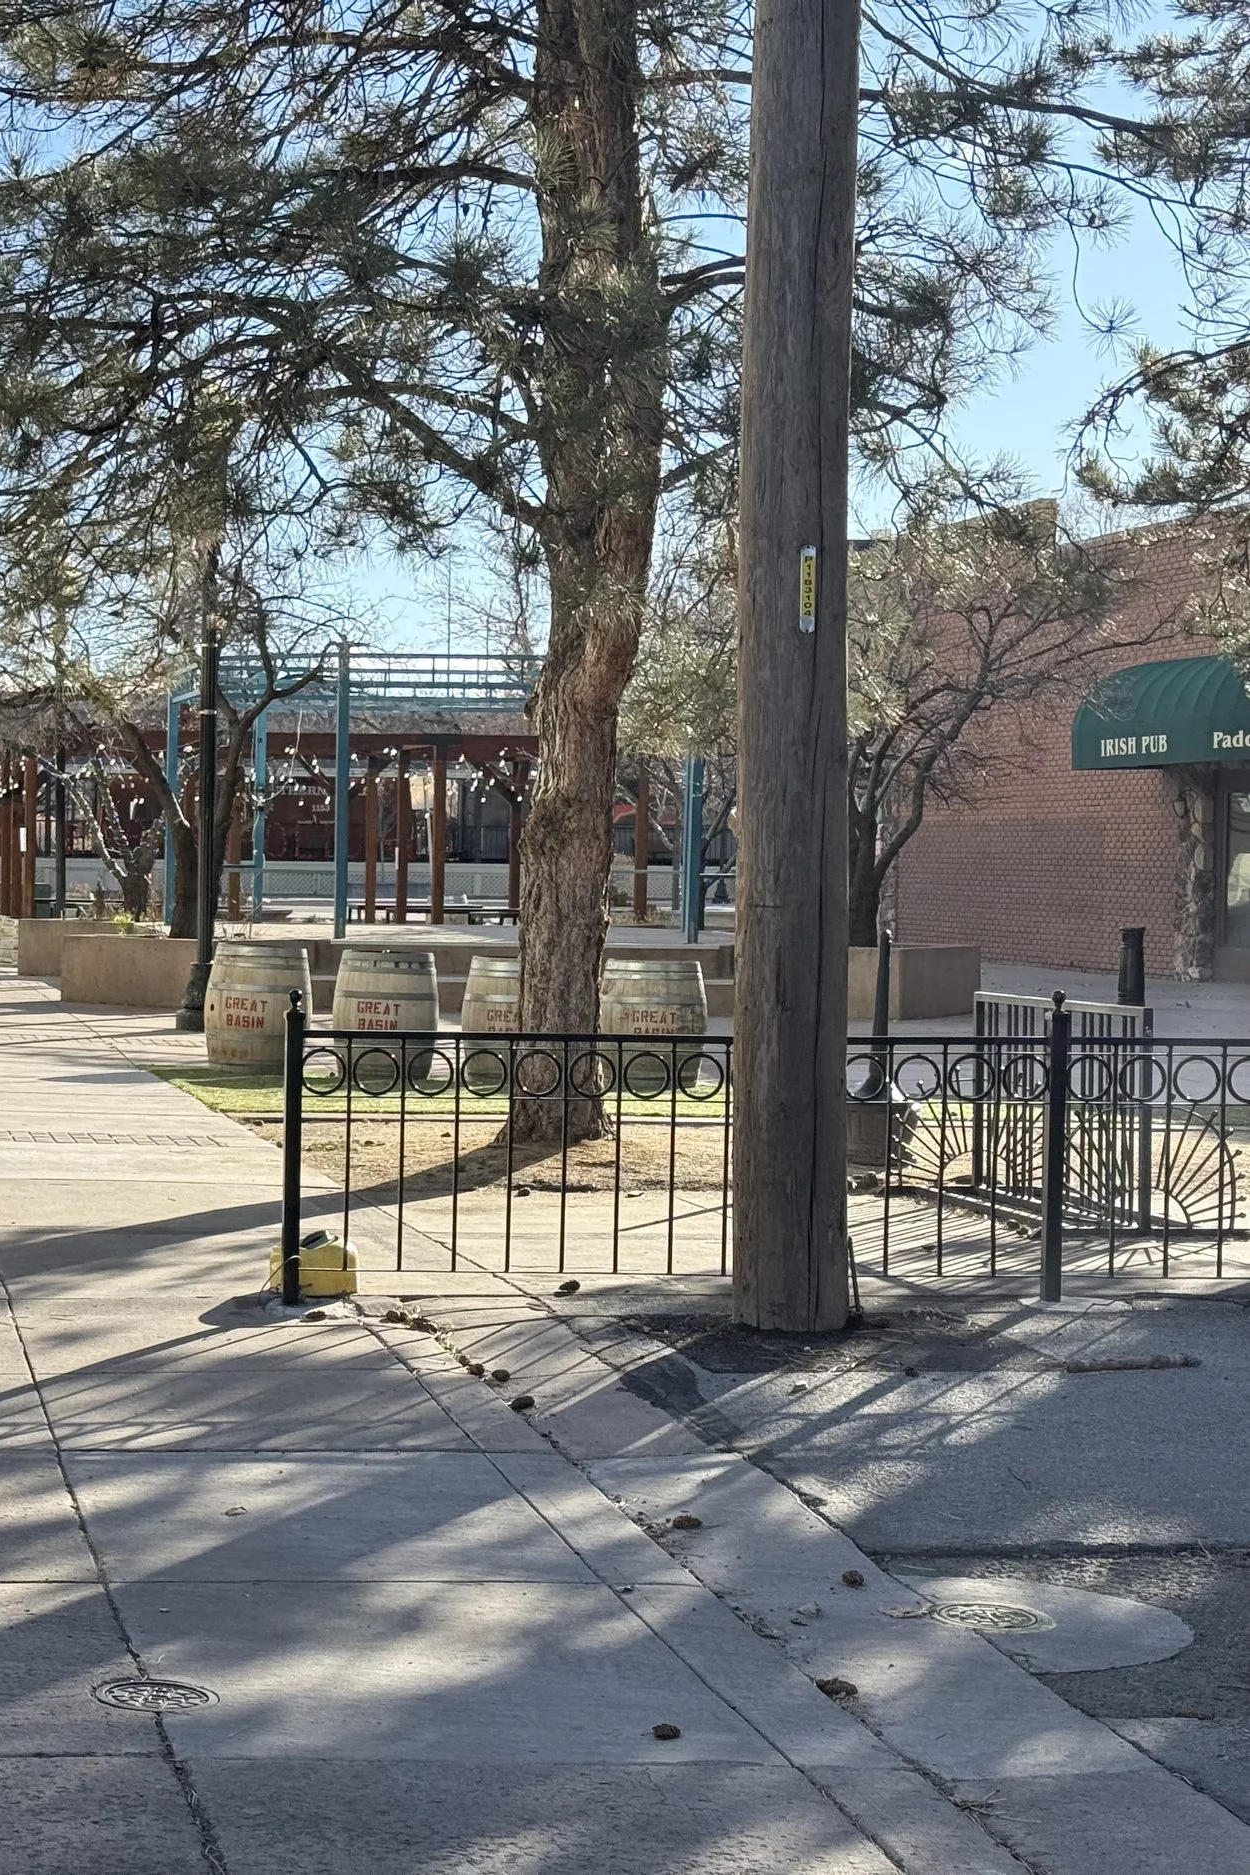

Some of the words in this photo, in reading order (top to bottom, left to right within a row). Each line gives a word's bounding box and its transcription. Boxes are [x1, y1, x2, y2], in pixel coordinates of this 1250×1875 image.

[1100, 736, 1136, 757] IRISH
[1141, 734, 1167, 754] PUB
[225, 996, 268, 1013] GREAT
[357, 1001, 401, 1016] GREAT
[226, 1013, 265, 1029] BASIN
[358, 1018, 398, 1030] BASIN
[632, 1009, 677, 1025] GREAT
